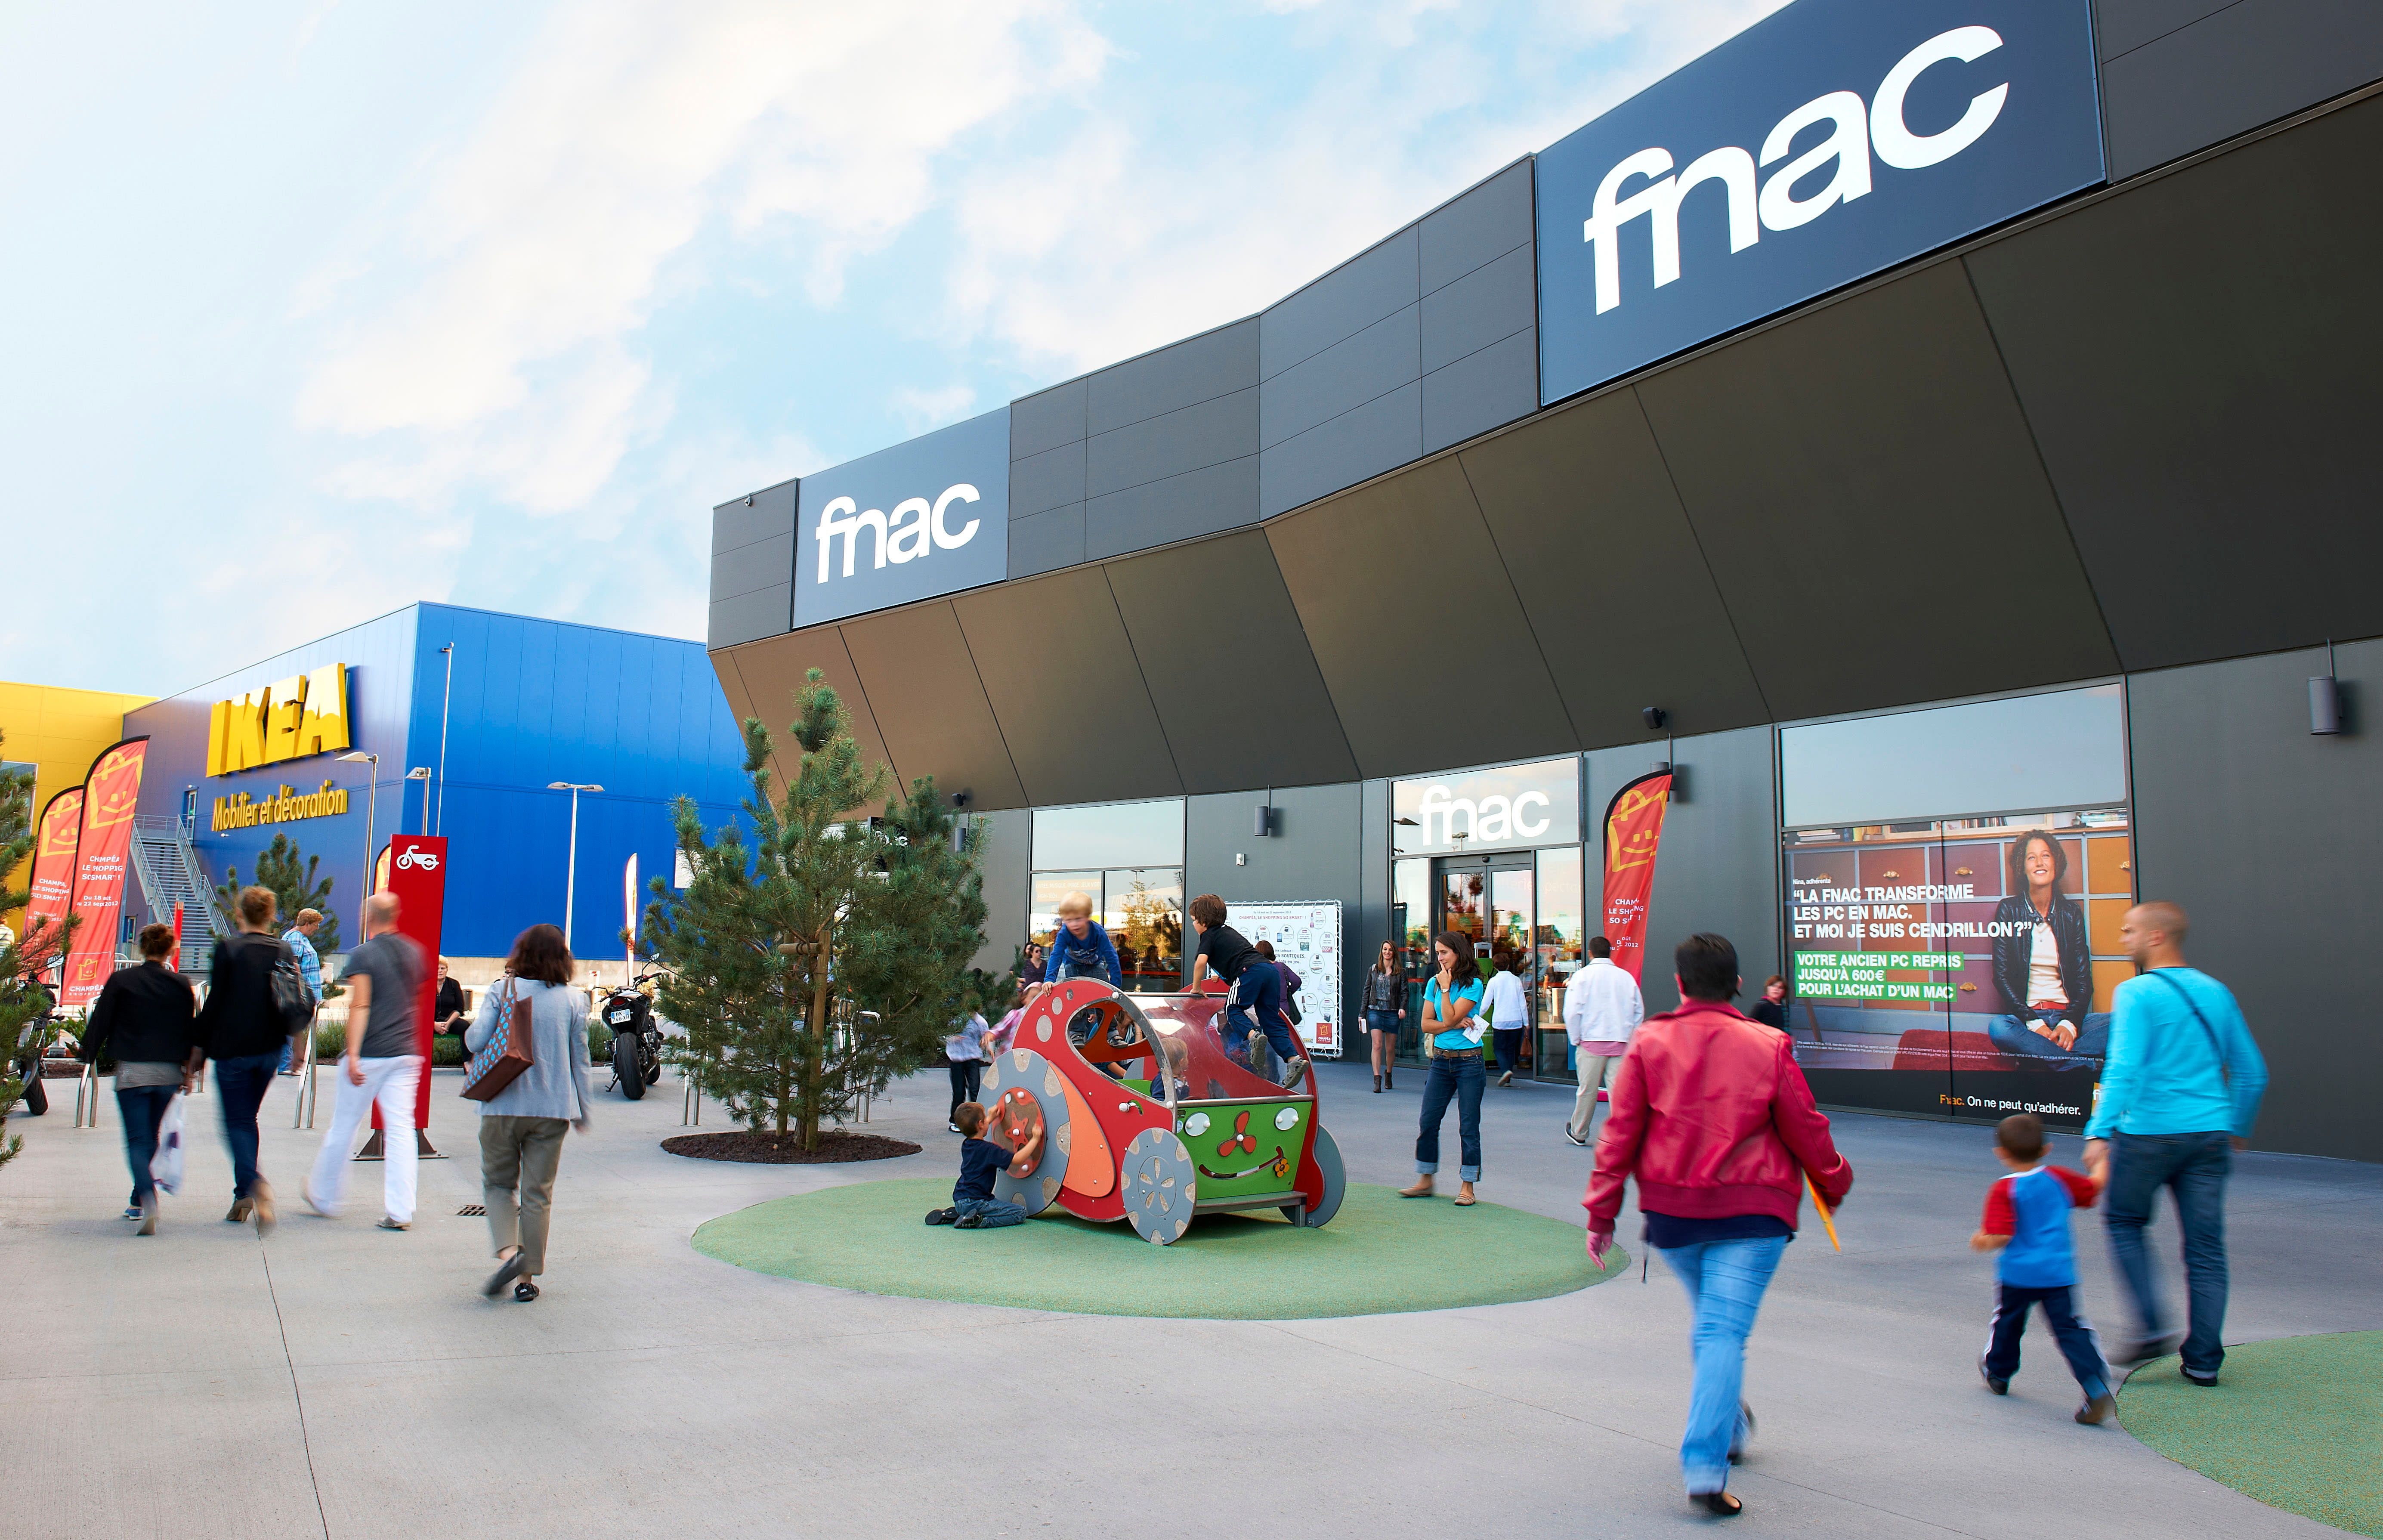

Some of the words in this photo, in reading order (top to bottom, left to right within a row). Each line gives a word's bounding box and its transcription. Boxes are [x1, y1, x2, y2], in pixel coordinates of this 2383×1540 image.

[1584, 25, 2008, 316] fnac
[816, 483, 980, 584] fnac
[206, 662, 350, 778] IKEA
[211, 791, 260, 832] Mobilier
[260, 794, 275, 825] et
[274, 779, 348, 823] décoration
[1419, 785, 1550, 846] fnac
[1822, 888, 1861, 902] FNAC
[1865, 884, 1974, 902] TRANSFORME
[1794, 906, 1820, 921] LES
[1824, 906, 1844, 920] PC
[1848, 905, 1868, 920] EN
[1873, 904, 1912, 920] MAC.
[1794, 924, 1812, 938] ET
[1816, 924, 1843, 938] MOI
[1847, 924, 1866, 938] JE
[1869, 923, 1905, 938] SUIS
[1797, 954, 1836, 966] VOTRE
[1839, 954, 1887, 966] ANCIEN
[1891, 954, 1909, 967] PC
[1912, 955, 1961, 968] REPRIS
[1798, 966, 1849, 981] JUSQU’À
[1852, 969, 1884, 981] 600€
[1798, 983, 1831, 995] POUR
[1835, 983, 1884, 996] L’ACHAT
[1888, 984, 1919, 998] D’UN
[1923, 985, 1953, 999] MAC
[1967, 1095, 1981, 1107] On
[1984, 1099, 1996, 1108] ne
[1999, 1100, 2021, 1110] peut
[2024, 1102, 2081, 1115] qu’adhérer.
